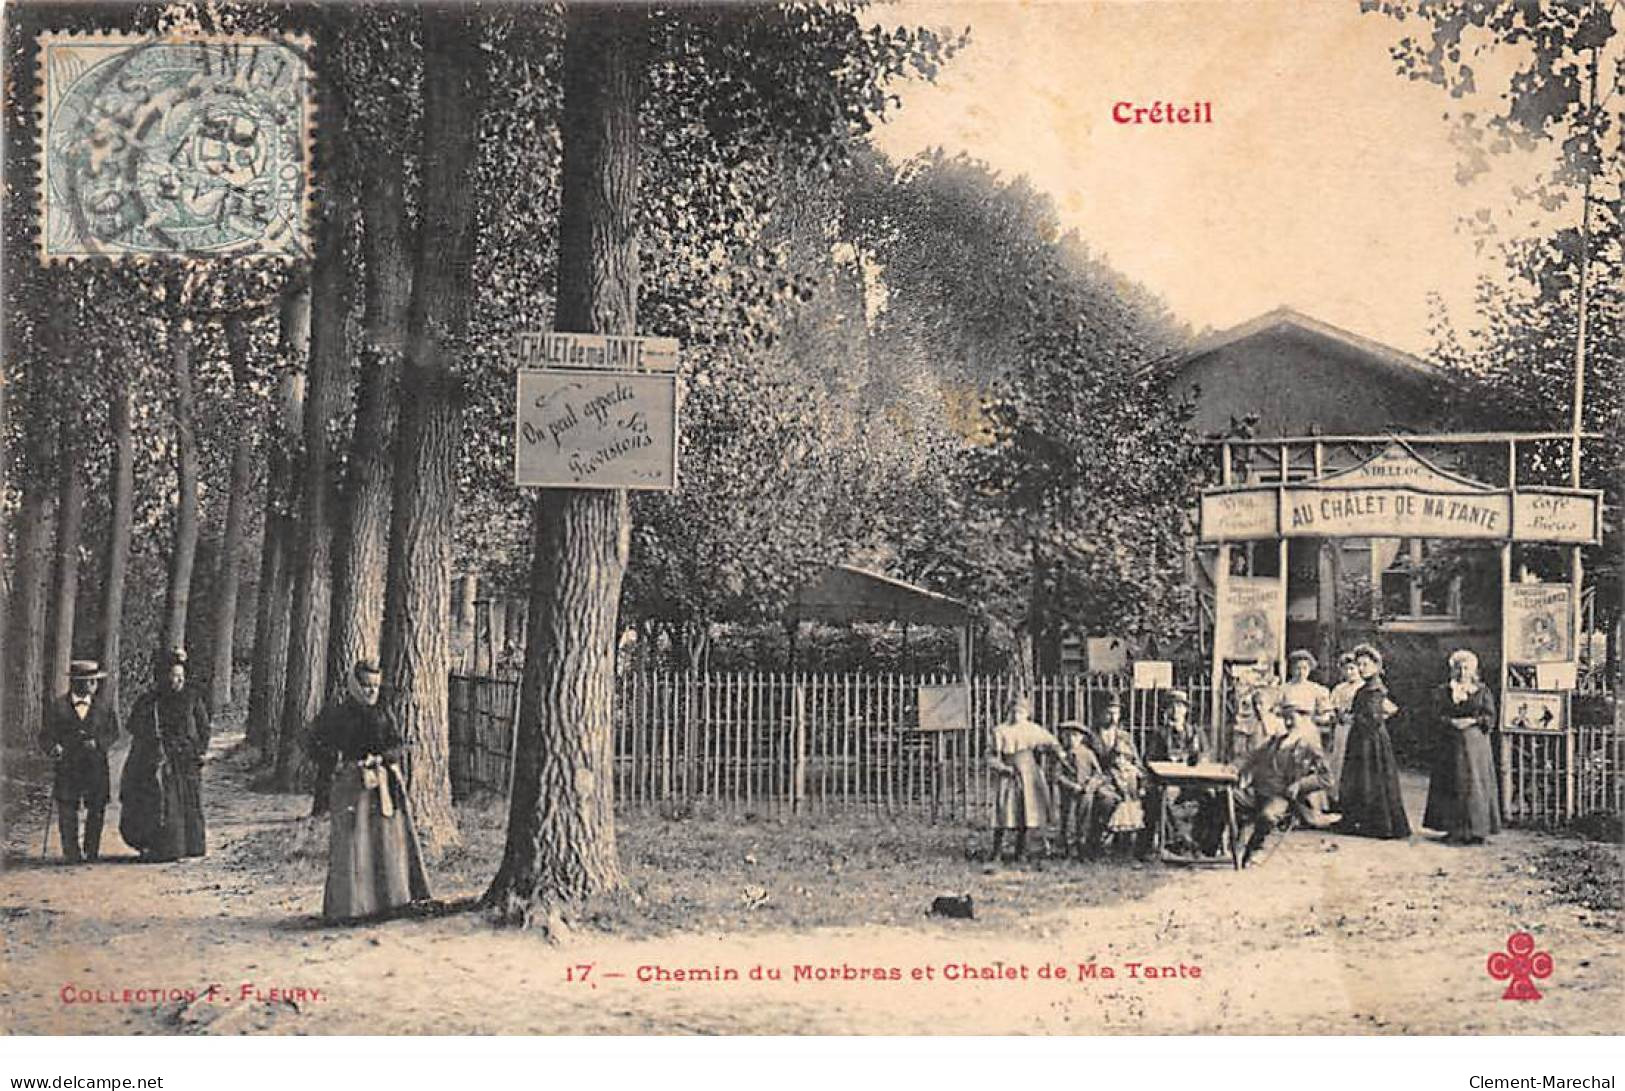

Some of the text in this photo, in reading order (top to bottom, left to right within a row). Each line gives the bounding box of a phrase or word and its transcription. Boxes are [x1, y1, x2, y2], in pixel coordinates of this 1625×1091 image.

[1292, 503, 1314, 528] AU
[1395, 495, 1415, 516] DE
[1423, 498, 1445, 519] MA
[1448, 500, 1500, 530] TANTE
